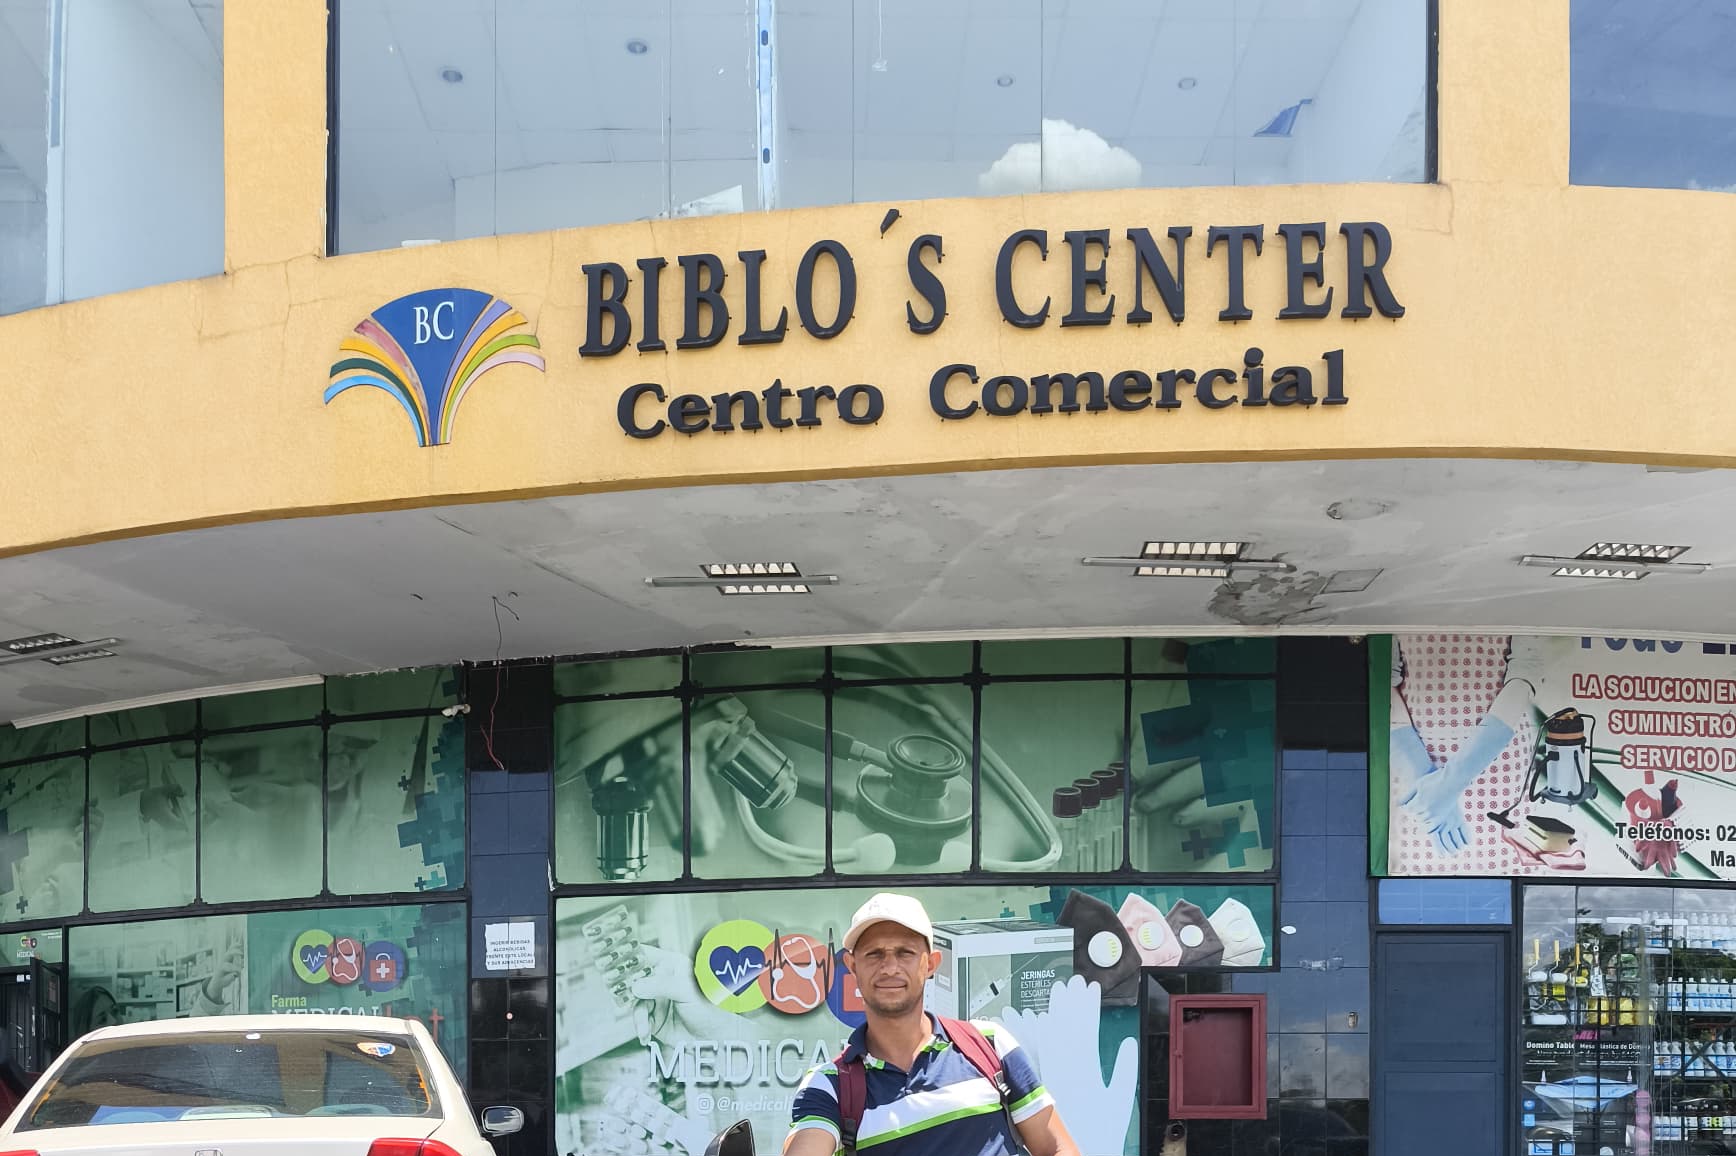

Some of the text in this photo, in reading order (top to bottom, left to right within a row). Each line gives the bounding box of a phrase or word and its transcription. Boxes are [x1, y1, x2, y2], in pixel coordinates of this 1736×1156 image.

[995, 221, 1406, 329] CENTER
[413, 301, 455, 345] BC
[617, 347, 1349, 439] Centro Comercial
[1573, 674, 1602, 699] LA
[1605, 675, 1711, 703] SOLUCION
[1621, 744, 1719, 771] SERVICIO
[1615, 822, 1710, 841] Teléfonos:
[1021, 970, 1055, 980] JERINGAS
[271, 994, 307, 1008] Farma
